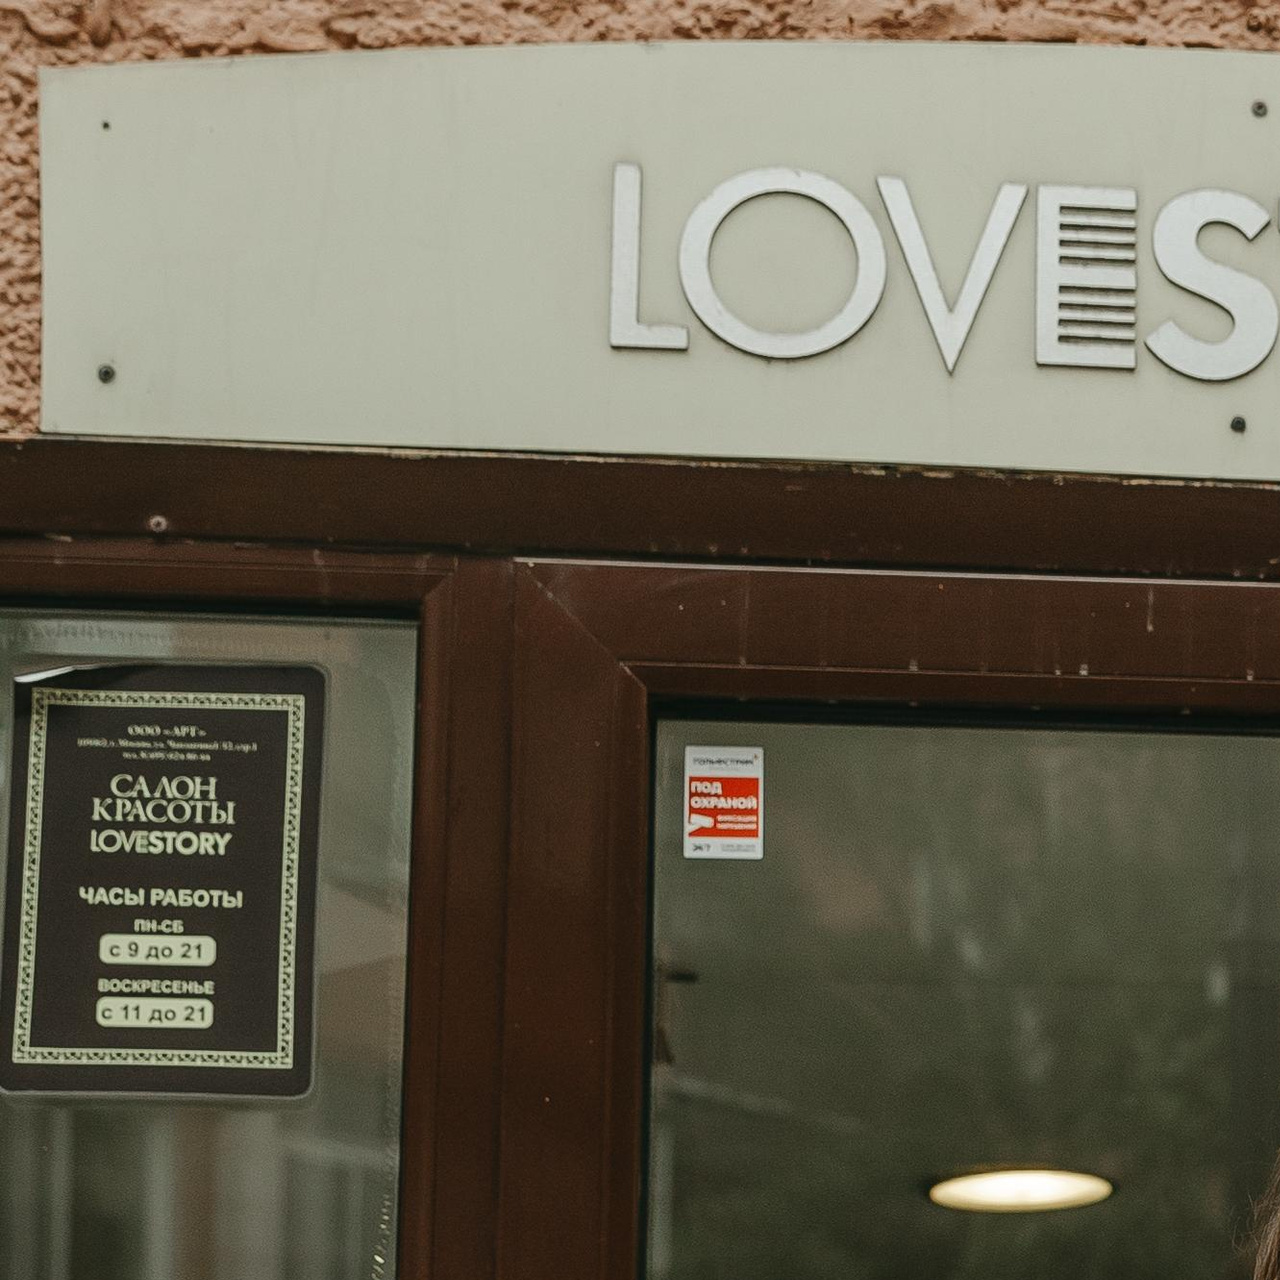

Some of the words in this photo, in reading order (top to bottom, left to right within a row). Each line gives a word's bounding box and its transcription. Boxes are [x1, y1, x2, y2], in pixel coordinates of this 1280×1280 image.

[110, 773, 217, 800] САЛОН
[92, 797, 236, 824] КРАСОТЫ
[90, 829, 232, 856] LOVESTORY
[78, 886, 145, 906] ЧАСЫ
[150, 888, 243, 908] РАБОТЫ
[134, 918, 184, 933] ПН-СБ
[128, 941, 139, 957] 9
[145, 945, 173, 960] до
[180, 943, 202, 958] 21
[97, 978, 215, 995] ВОСКРЕСЕНЬЕ
[121, 1004, 141, 1020] 11
[149, 1008, 177, 1023] до
[184, 1005, 206, 1022] 21
